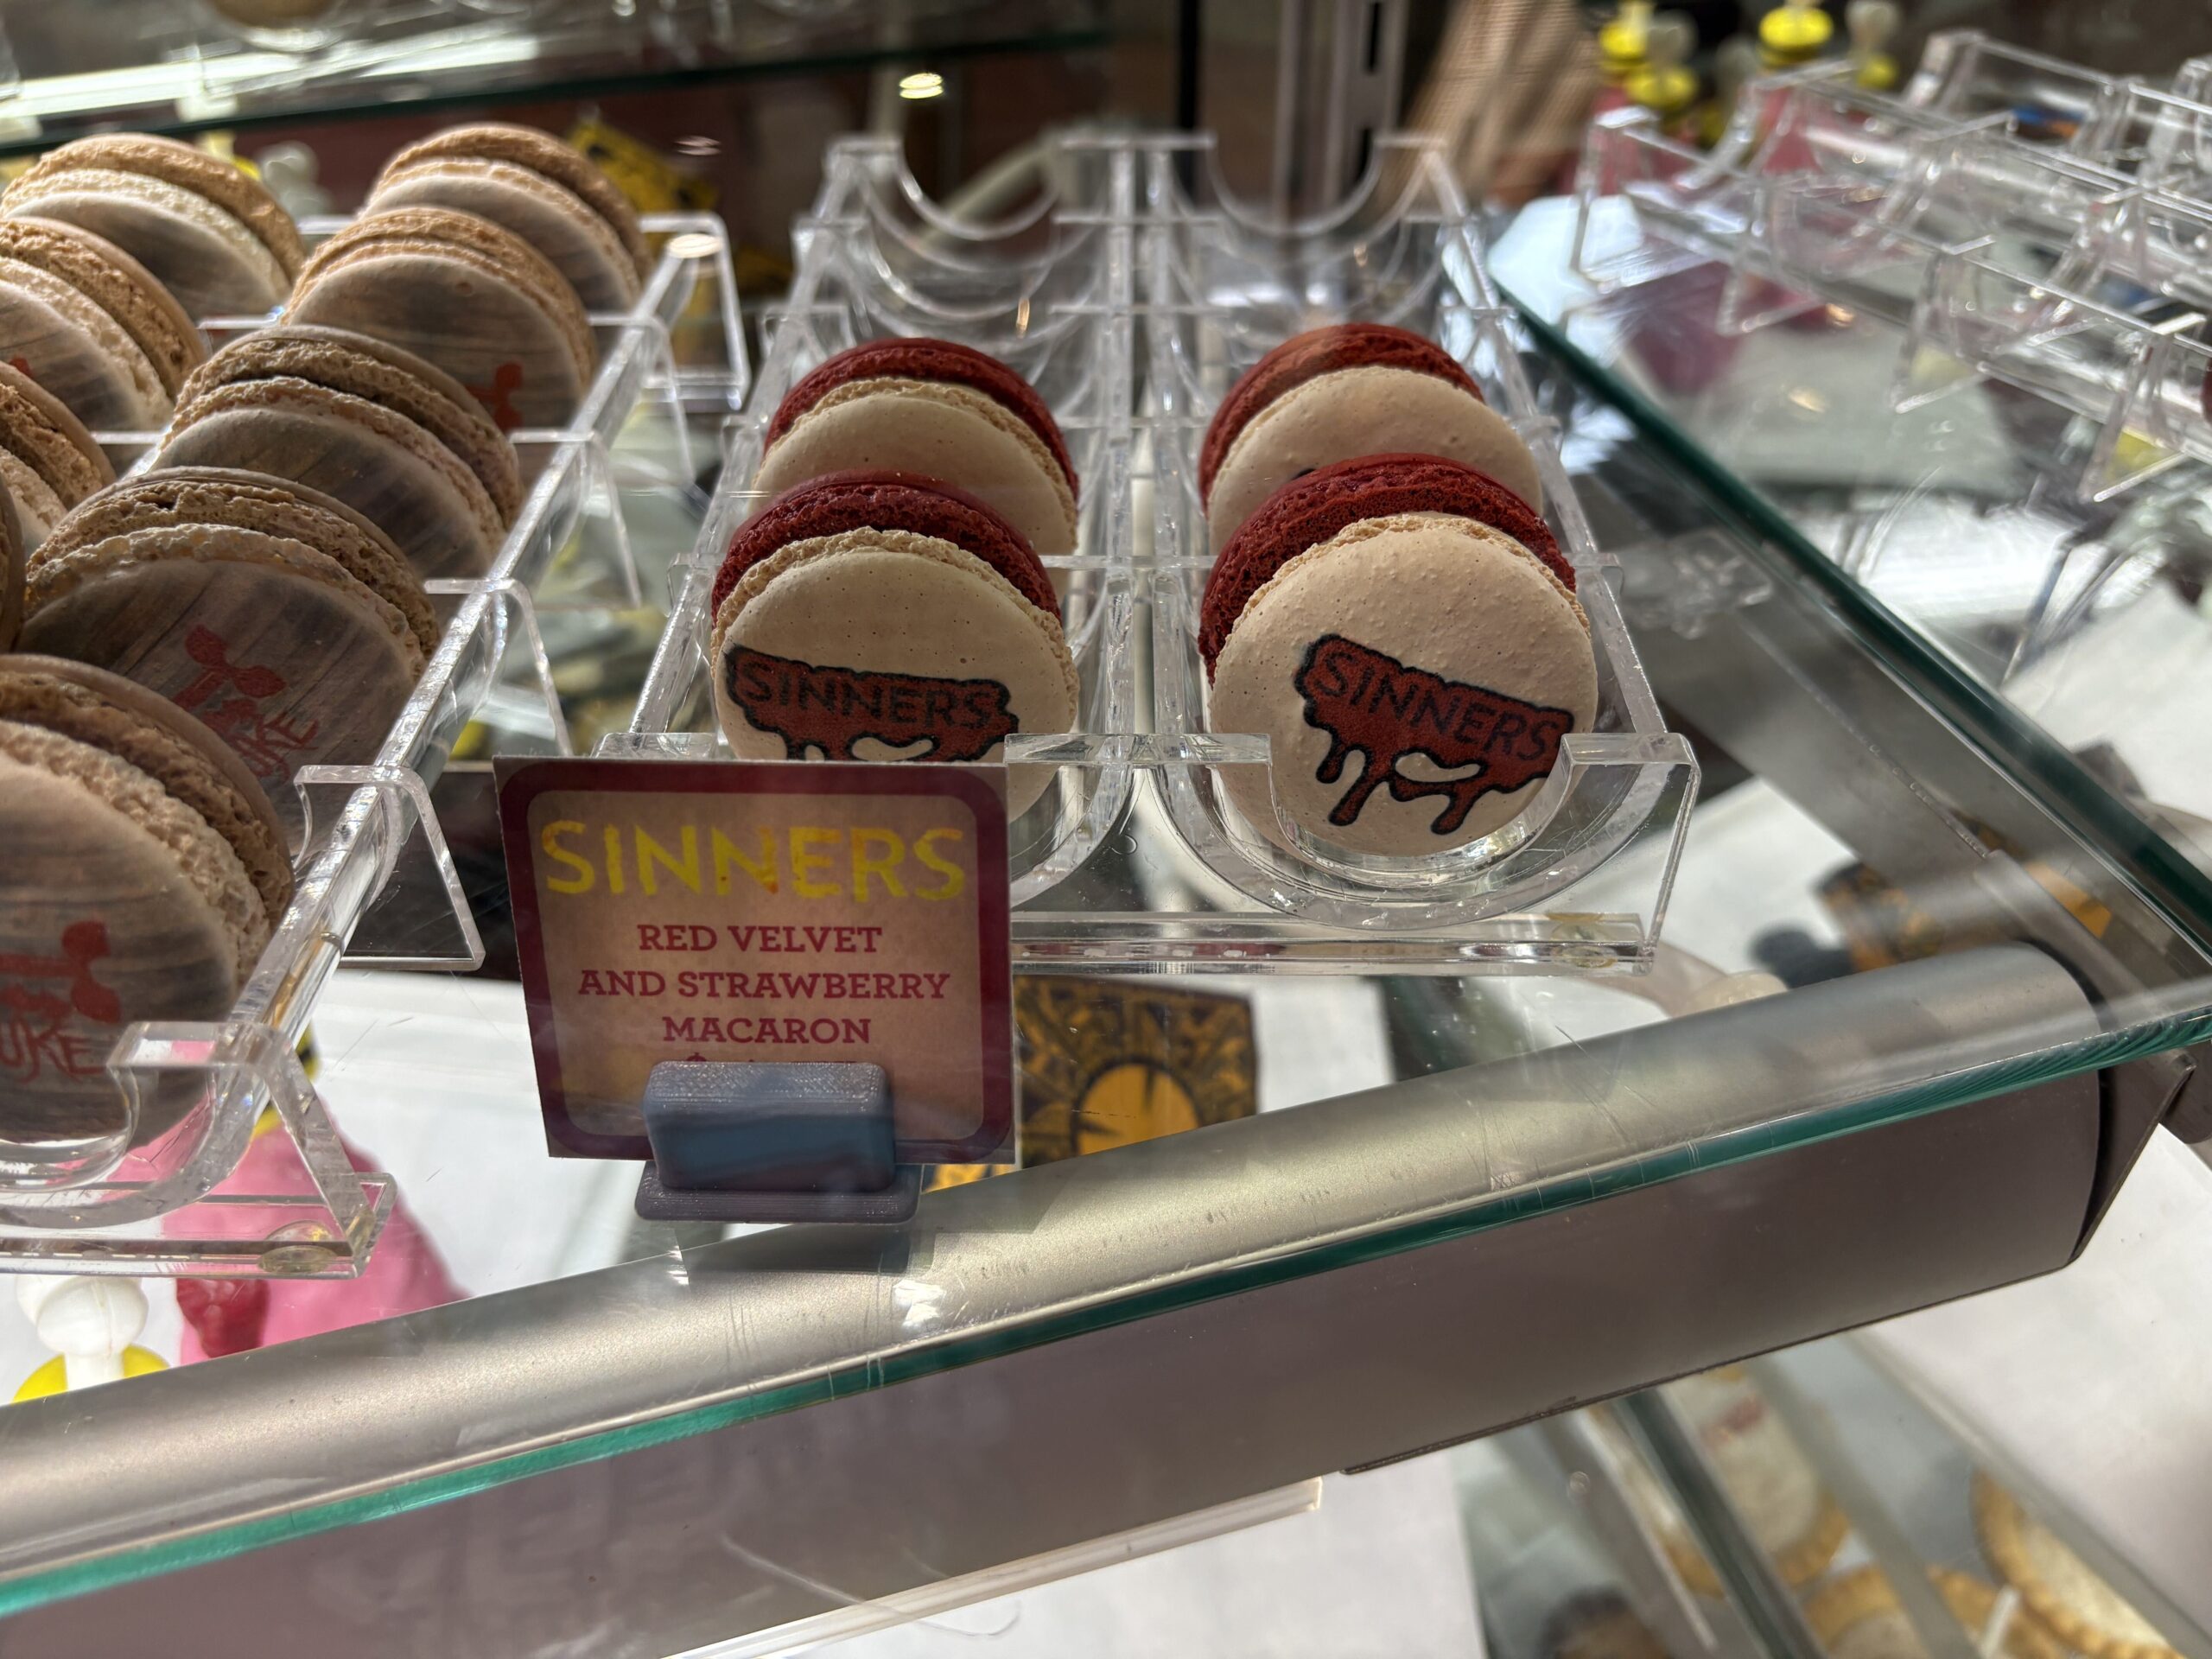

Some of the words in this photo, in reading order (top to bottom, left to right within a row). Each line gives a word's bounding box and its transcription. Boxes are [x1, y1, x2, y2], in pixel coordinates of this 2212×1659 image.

[738, 660, 992, 729] SINNERS
[1313, 651, 1556, 761] SINNERS
[540, 820, 967, 903] SINNERS
[637, 924, 718, 952] RED
[728, 925, 882, 953] VELVET
[578, 969, 665, 997] AND
[677, 971, 950, 999] STRAWBERRY
[662, 1016, 871, 1044] MACARON
